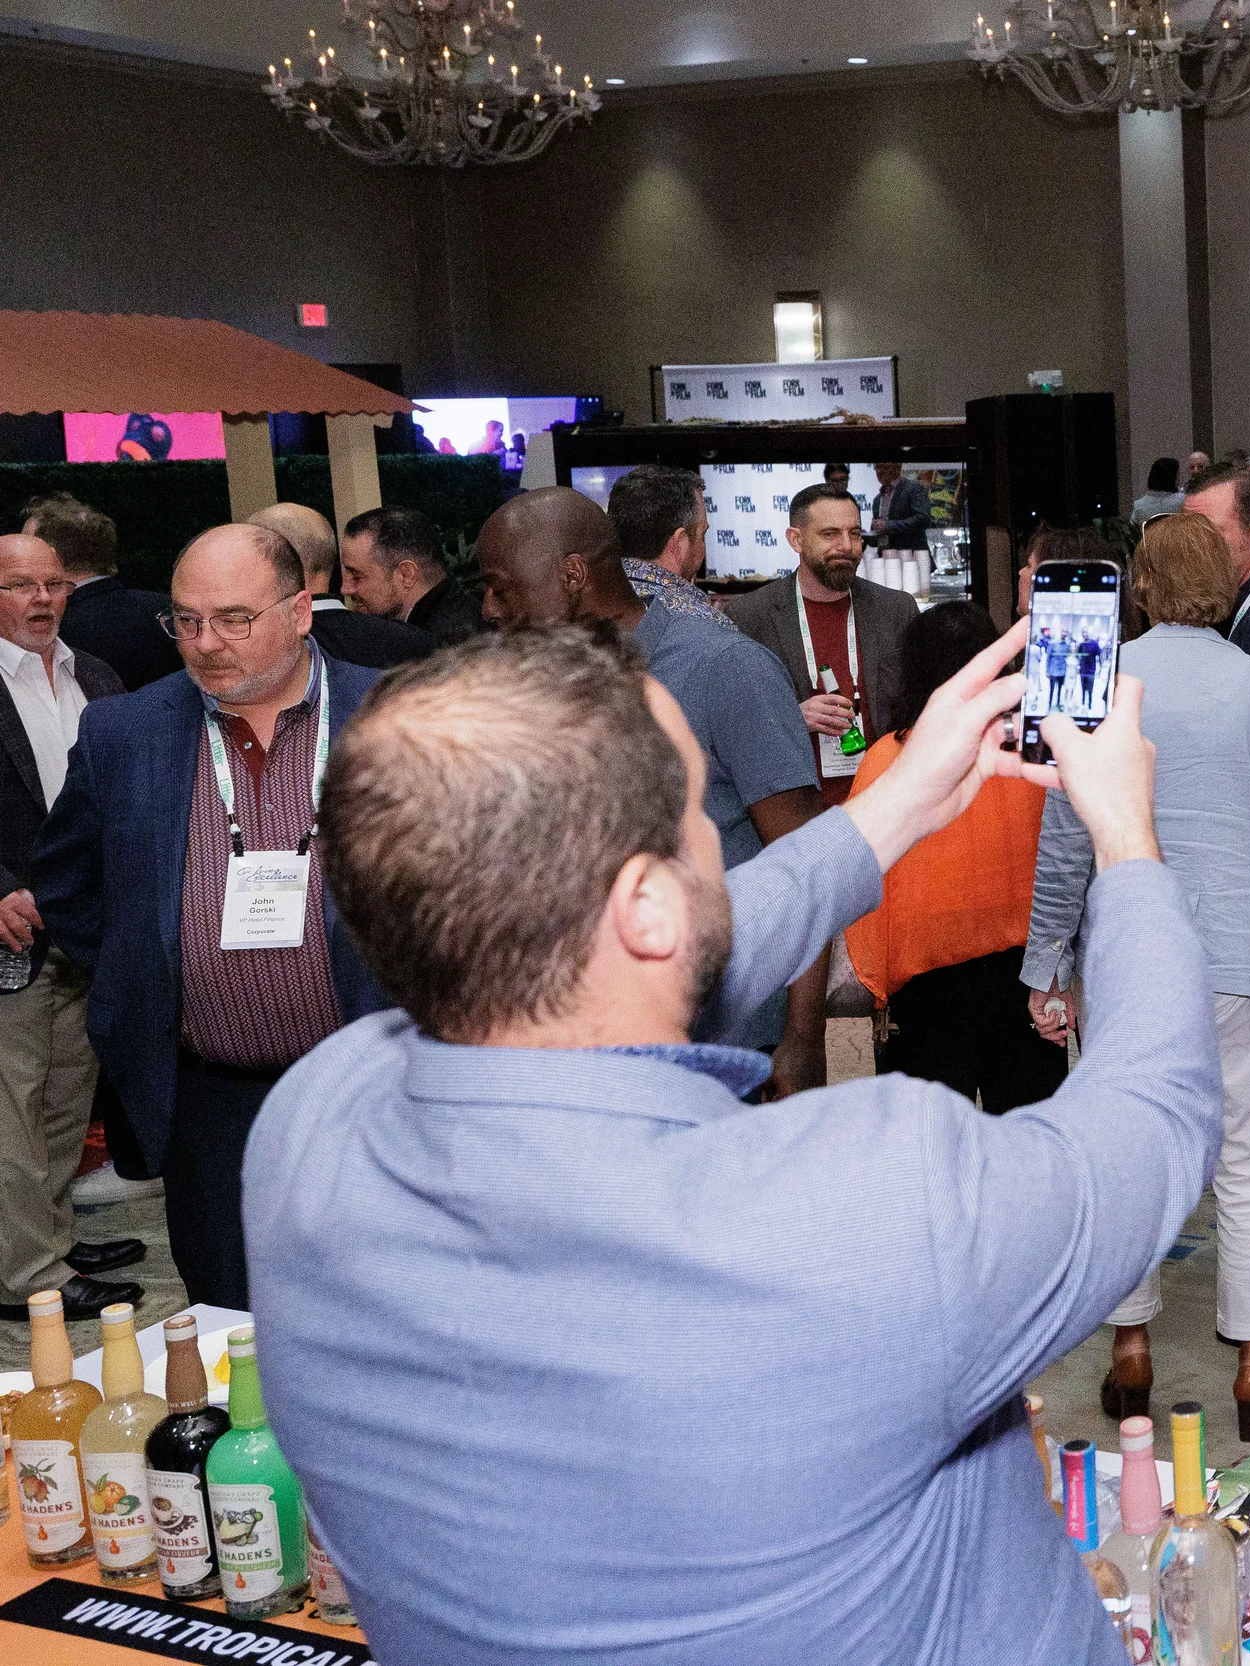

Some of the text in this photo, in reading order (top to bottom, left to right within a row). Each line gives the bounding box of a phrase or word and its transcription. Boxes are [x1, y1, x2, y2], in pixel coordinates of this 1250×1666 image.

[783, 379, 800, 388] FORK
[821, 377, 839, 386] FORK
[860, 375, 878, 384] FORK
[670, 382, 687, 391] FORK
[707, 382, 723, 390] FORK
[745, 381, 762, 389] FORK
[867, 384, 883, 394] FILM
[676, 391, 691, 400] FILM
[712, 390, 728, 399] FILM
[750, 389, 766, 398] FILM
[788, 387, 805, 397] FILM
[827, 386, 844, 396] FILM
[735, 495, 751, 504] FORK
[772, 495, 789, 504] FORK
[741, 504, 756, 513] FILM
[717, 530, 735, 539] FORK
[755, 529, 772, 538] FORK
[723, 538, 740, 547] FILM
[761, 537, 777, 546] FILM
[211, 739, 224, 766] Littler
[219, 778, 232, 804] Littler
